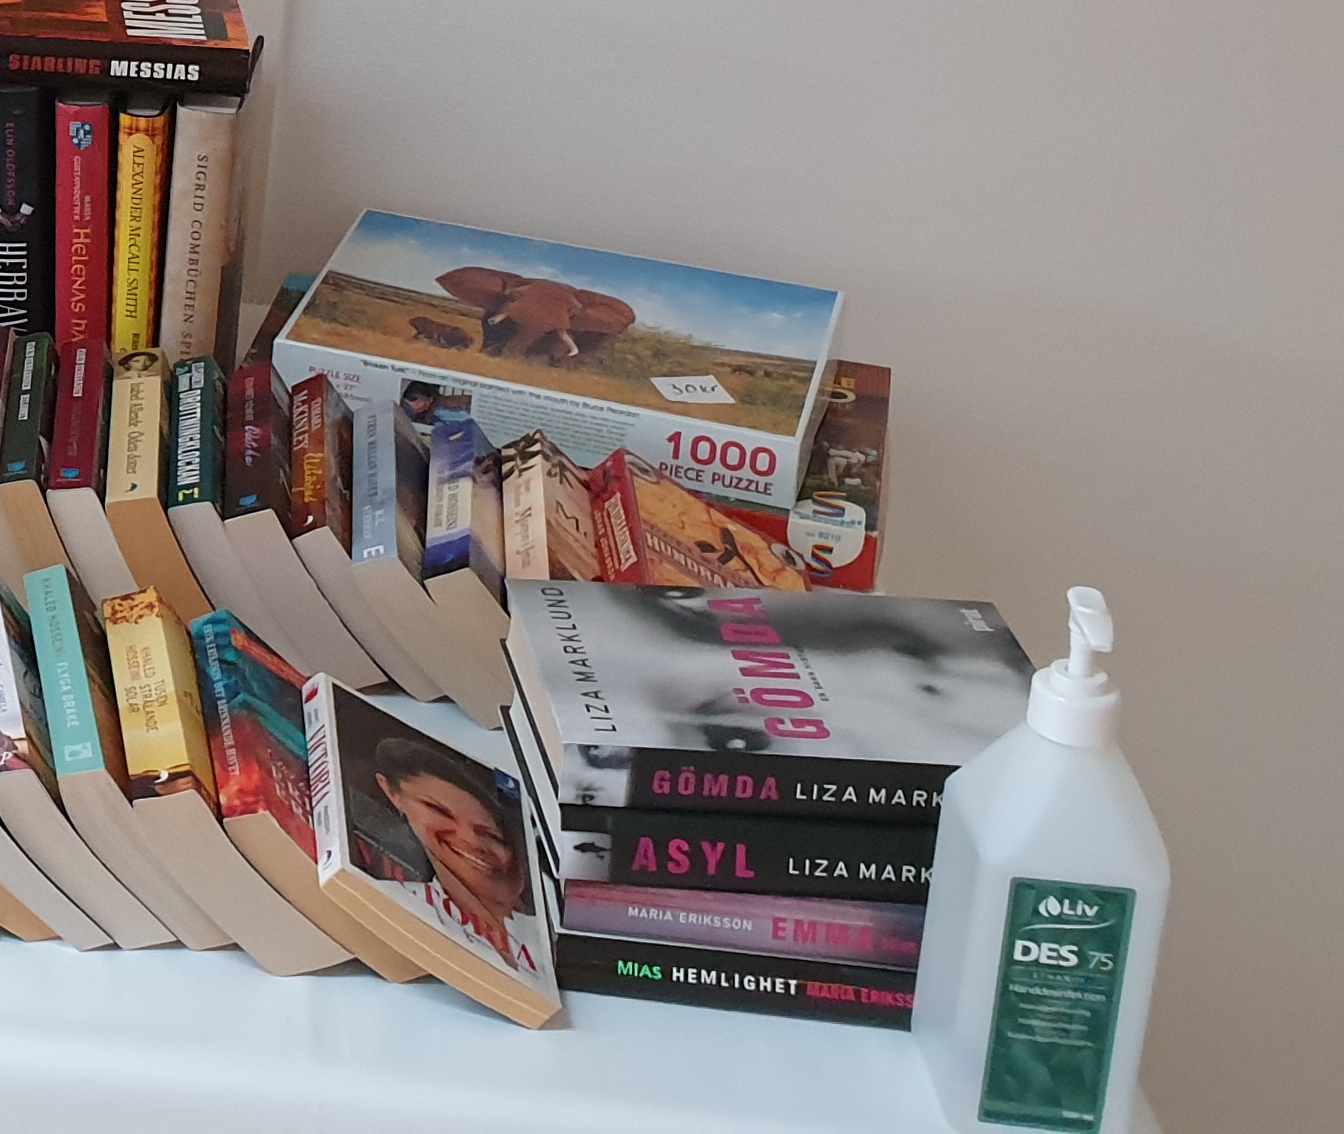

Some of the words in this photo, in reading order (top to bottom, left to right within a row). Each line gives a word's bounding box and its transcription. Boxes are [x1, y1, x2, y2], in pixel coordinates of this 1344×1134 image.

[110, 60, 200, 81] MESSIAS
[129, 144, 146, 224] ALEXANDER
[195, 153, 209, 213] SIGRID
[183, 218, 204, 325] COMBÜCHEN
[125, 274, 142, 321] SMITH
[666, 431, 778, 477] 1000
[659, 462, 705, 484] PIECE
[711, 472, 774, 497] PUZZLE
[550, 586, 597, 683] MARKLUND
[56, 662, 71, 691] FLYGA
[707, 596, 831, 741] GÖMDA
[61, 694, 80, 728] DRAKE
[581, 689, 617, 733] LIZA
[651, 767, 779, 801] GÖMDA
[795, 783, 859, 804] LIZA
[631, 837, 755, 879] ASYL
[788, 858, 848, 878] LIZA
[627, 906, 674, 924] MARIA
[679, 911, 753, 931] ERIKSSON
[771, 916, 874, 953] EMMA
[1013, 939, 1079, 966] DES
[1088, 951, 1114, 971] 75
[616, 959, 663, 981] MIAS
[671, 967, 798, 997] HEMLIGHET
